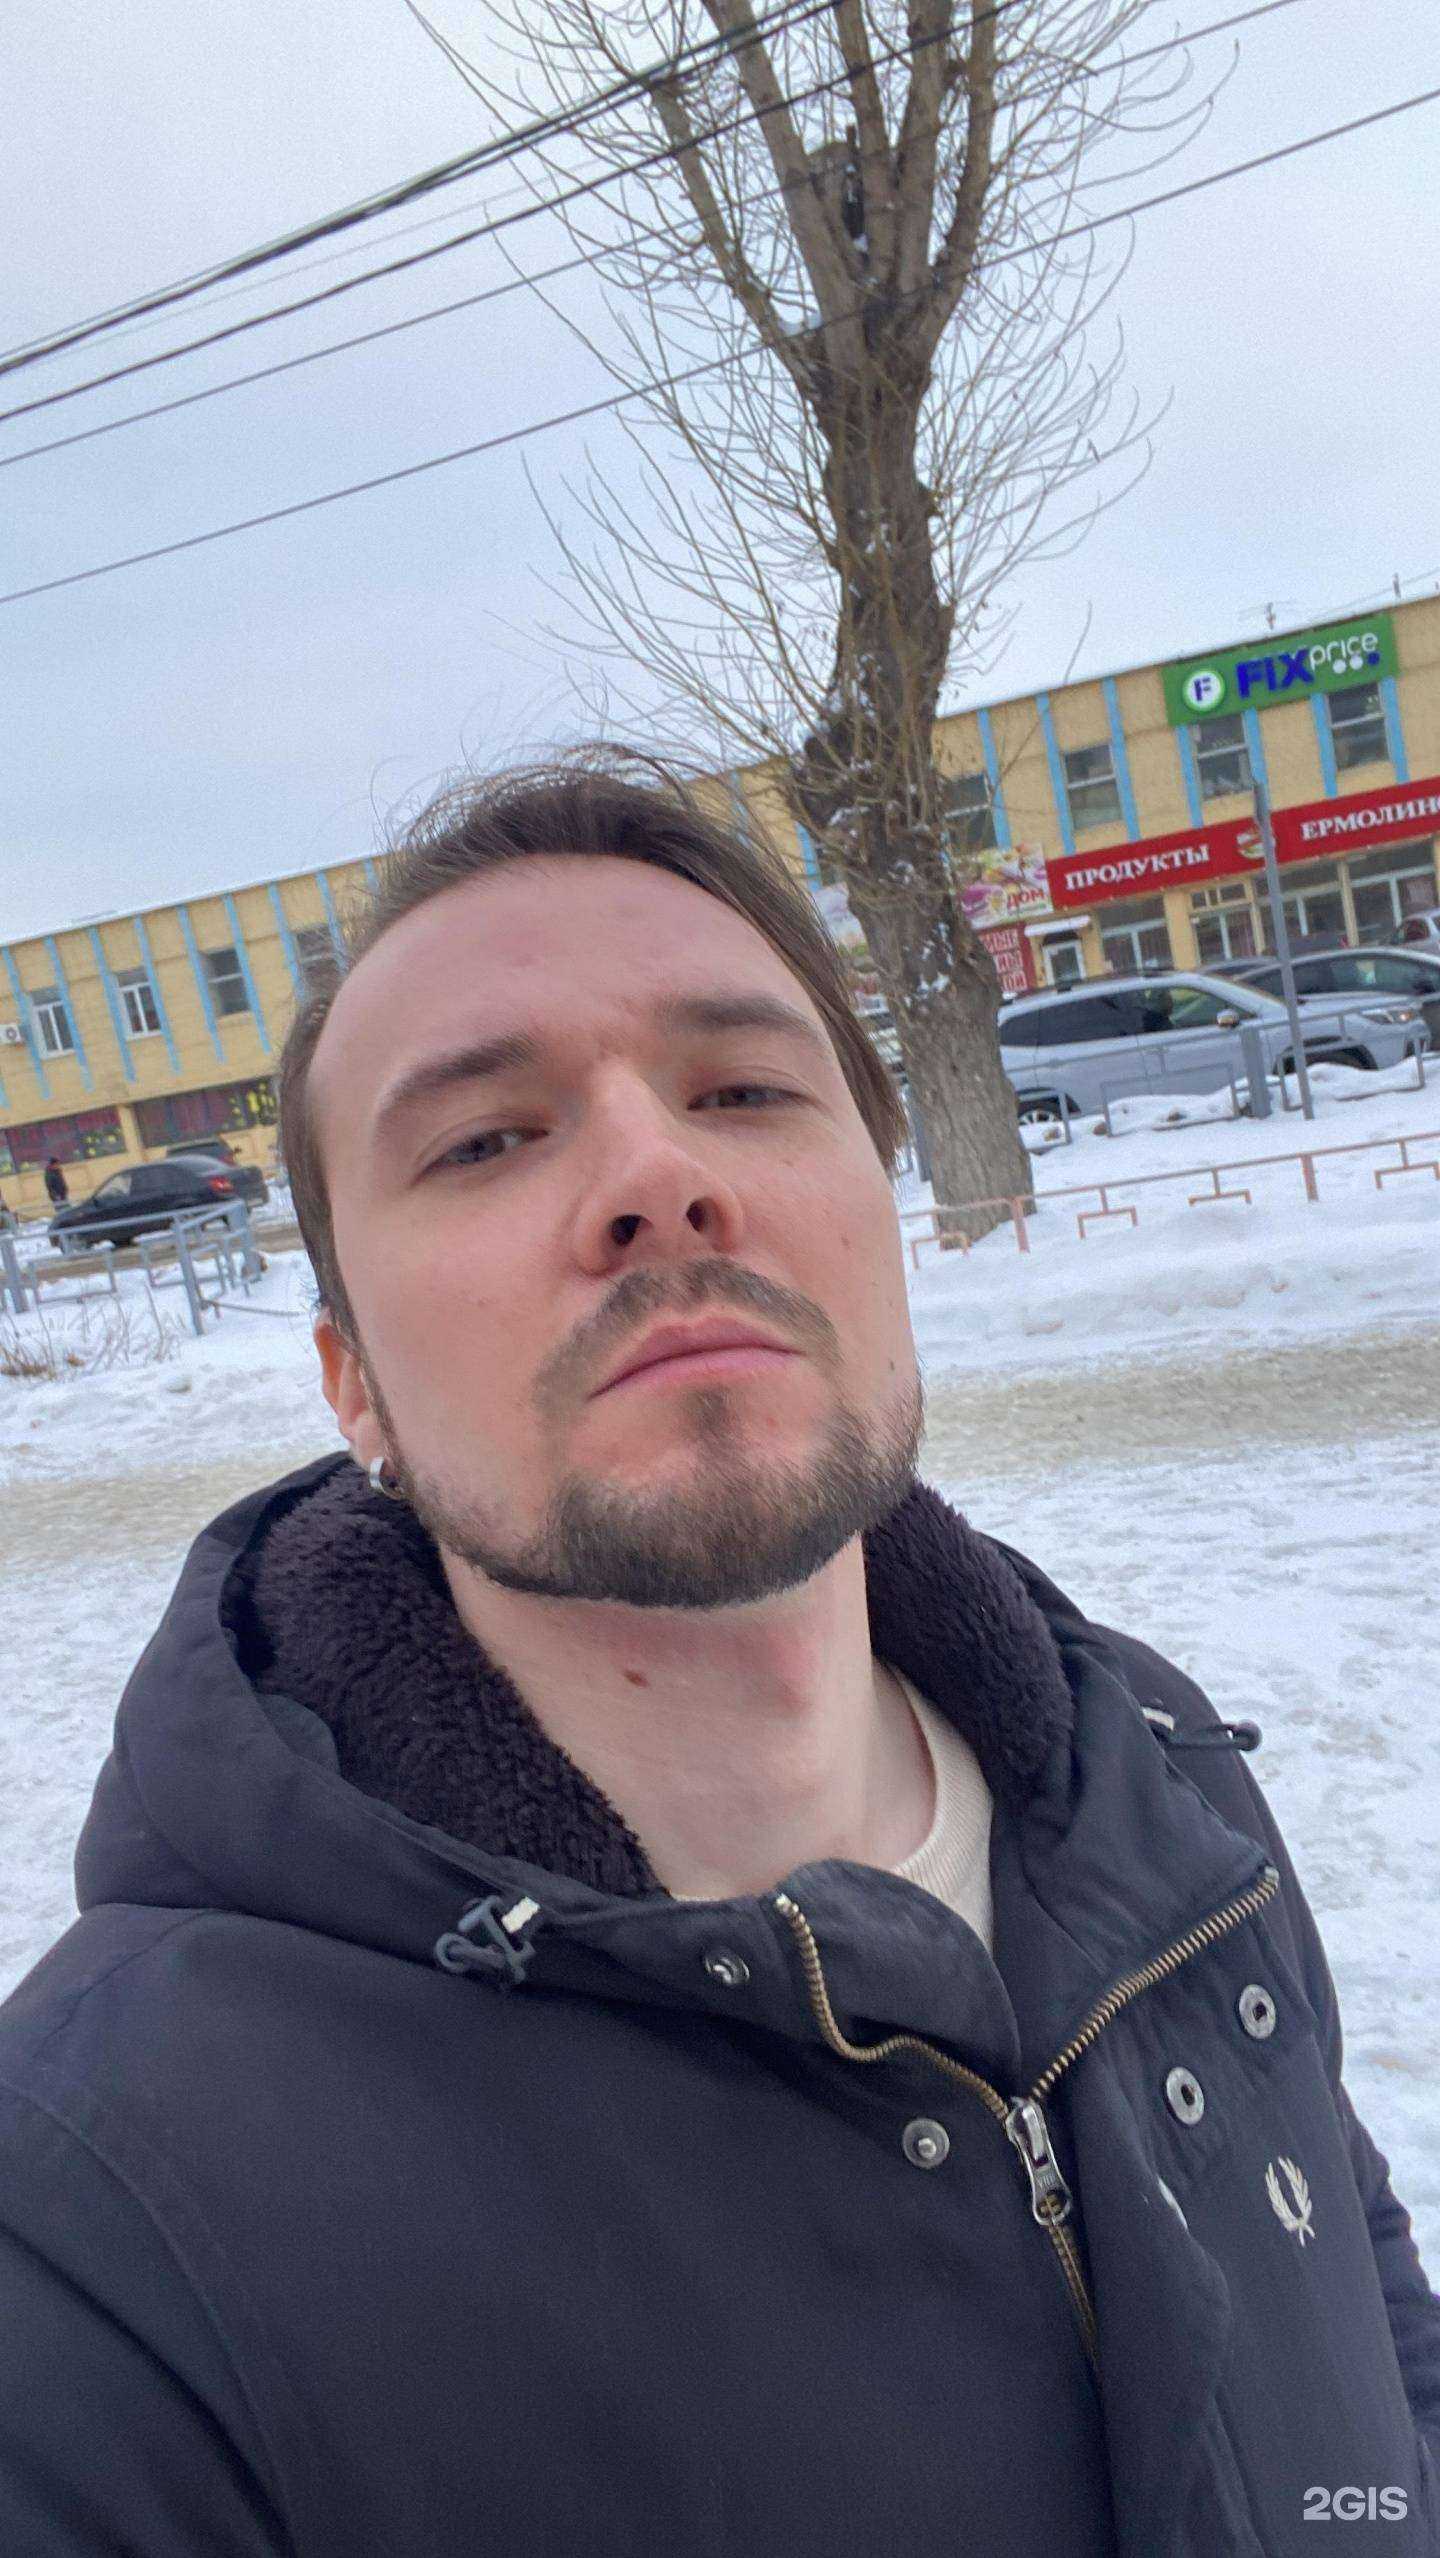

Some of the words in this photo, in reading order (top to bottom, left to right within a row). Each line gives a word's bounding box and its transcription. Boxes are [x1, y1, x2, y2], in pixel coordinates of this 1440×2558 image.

[1235, 649, 1314, 699] FIX
[1308, 632, 1379, 671] price
[1300, 795, 1440, 841] ЕРМОЛИН
[1065, 843, 1210, 891] ПРОДУКТЫ
